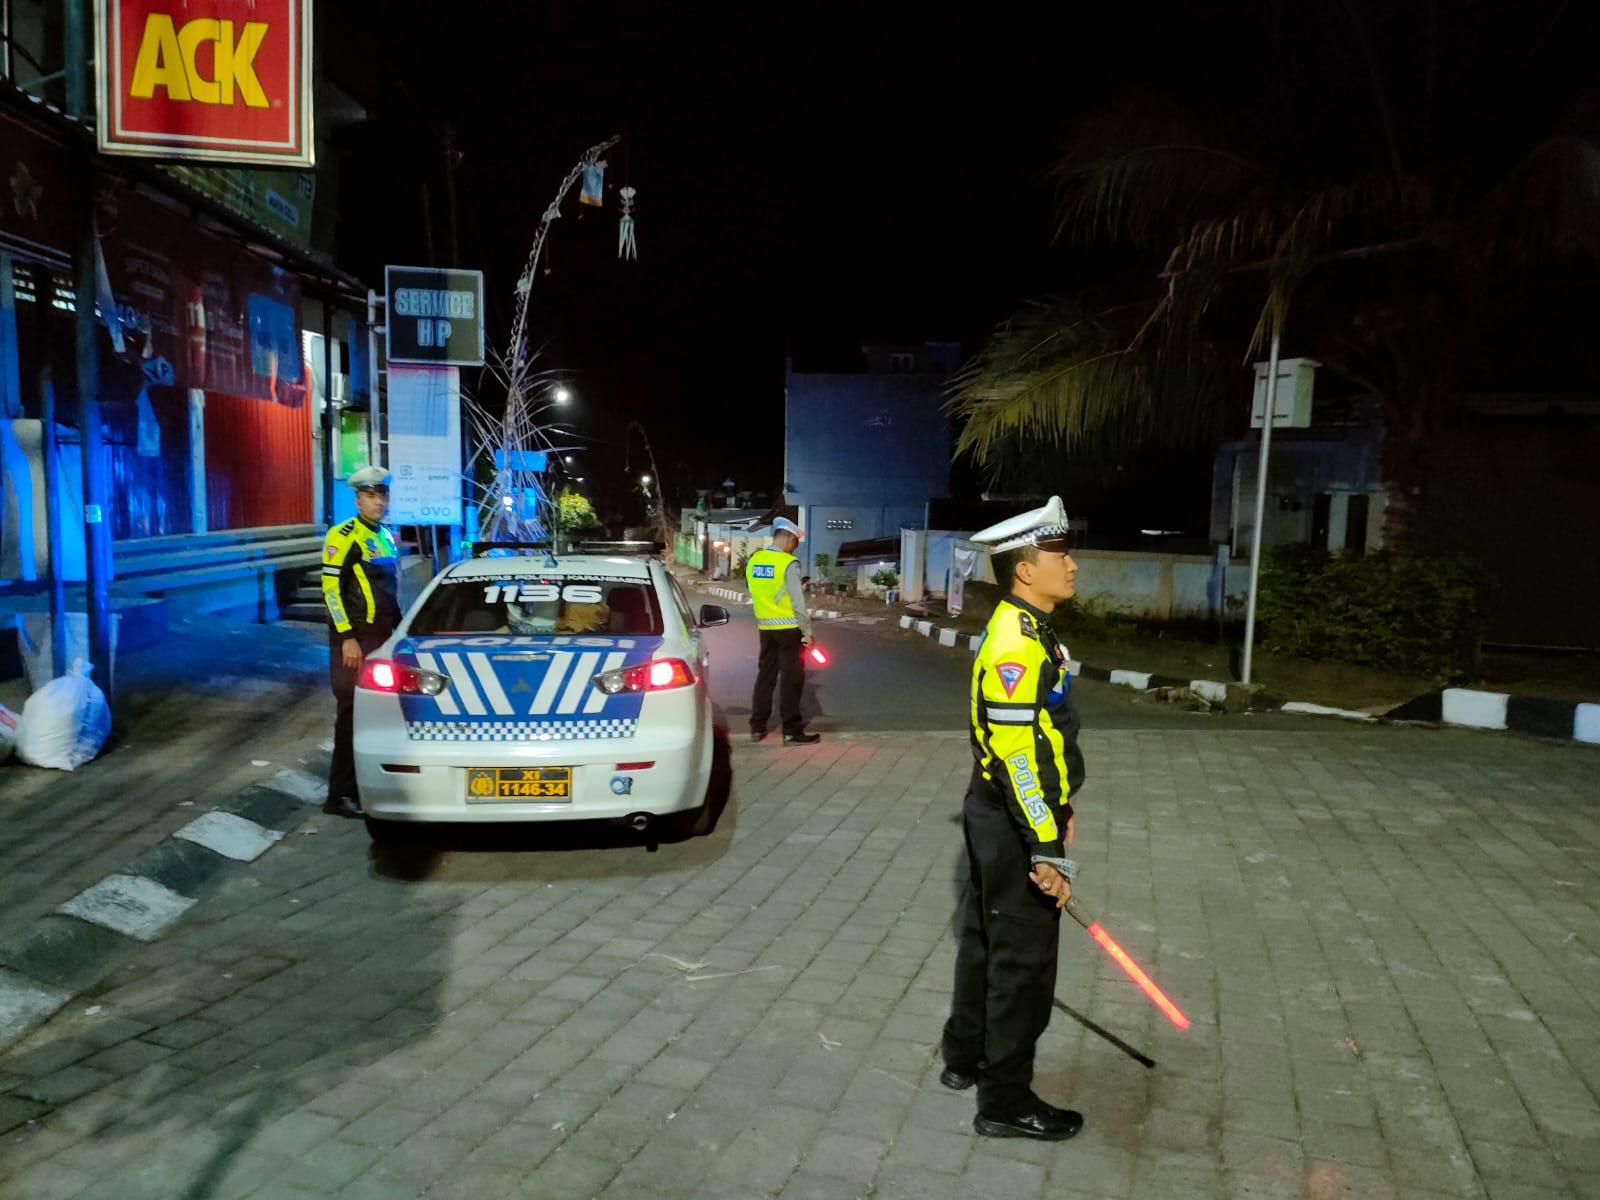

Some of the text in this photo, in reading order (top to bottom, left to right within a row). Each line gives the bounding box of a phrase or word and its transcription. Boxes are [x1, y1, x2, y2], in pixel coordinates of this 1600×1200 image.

[129, 12, 271, 109] ACK
[395, 287, 474, 318] SERVICE
[417, 318, 453, 348] HP
[482, 585, 603, 604] 1136
[417, 635, 637, 650] POLISI
[500, 782, 566, 796] 1146-34
[1007, 752, 1049, 827] POLISI
